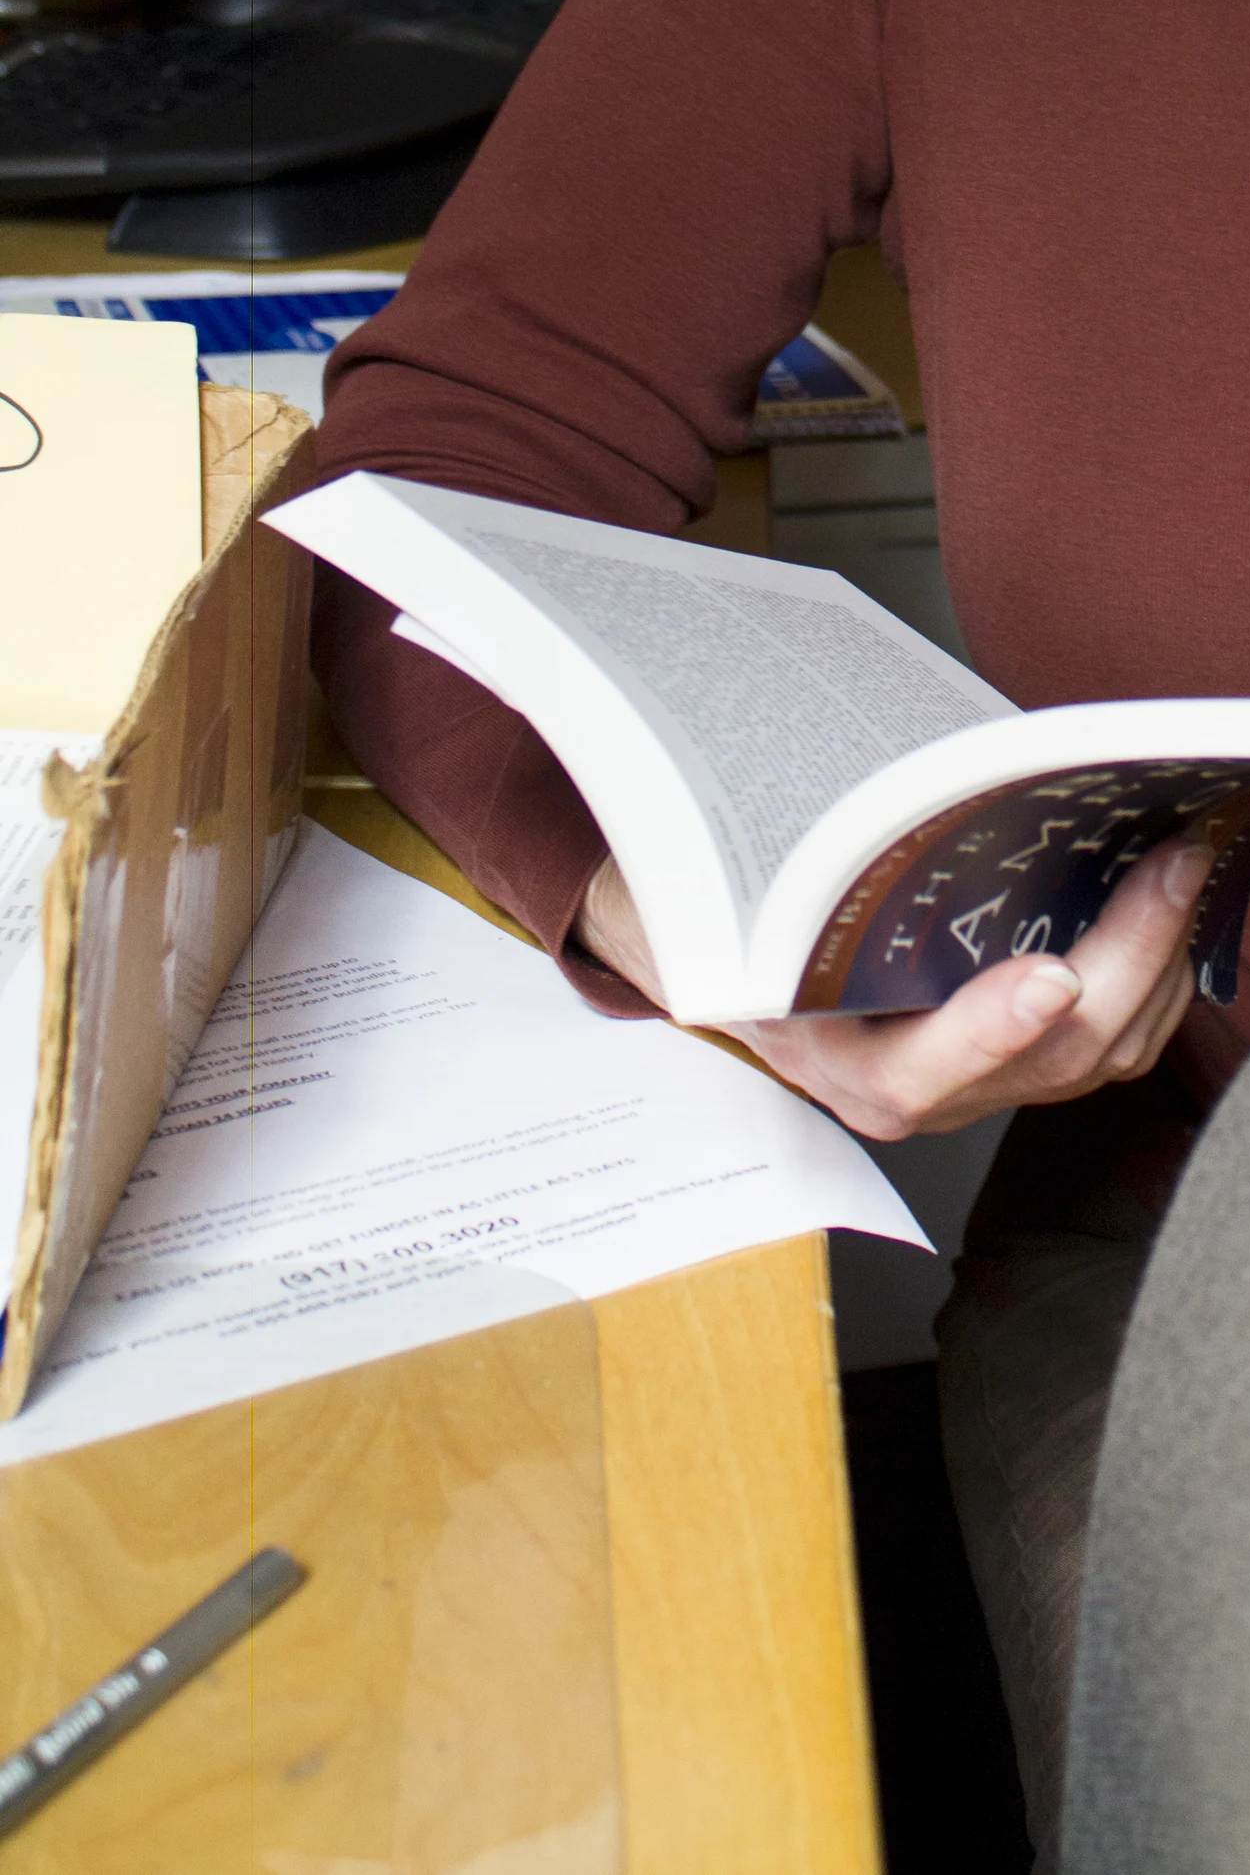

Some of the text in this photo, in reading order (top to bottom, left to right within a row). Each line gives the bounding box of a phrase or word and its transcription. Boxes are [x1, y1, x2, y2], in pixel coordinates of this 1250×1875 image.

[342, 969, 400, 986] Funding
[298, 996, 330, 1008] your
[332, 980, 394, 999] business
[205, 1088, 248, 1105] YOUR
[252, 1070, 334, 1094] COMPANY
[236, 1098, 294, 1118] HOURS
